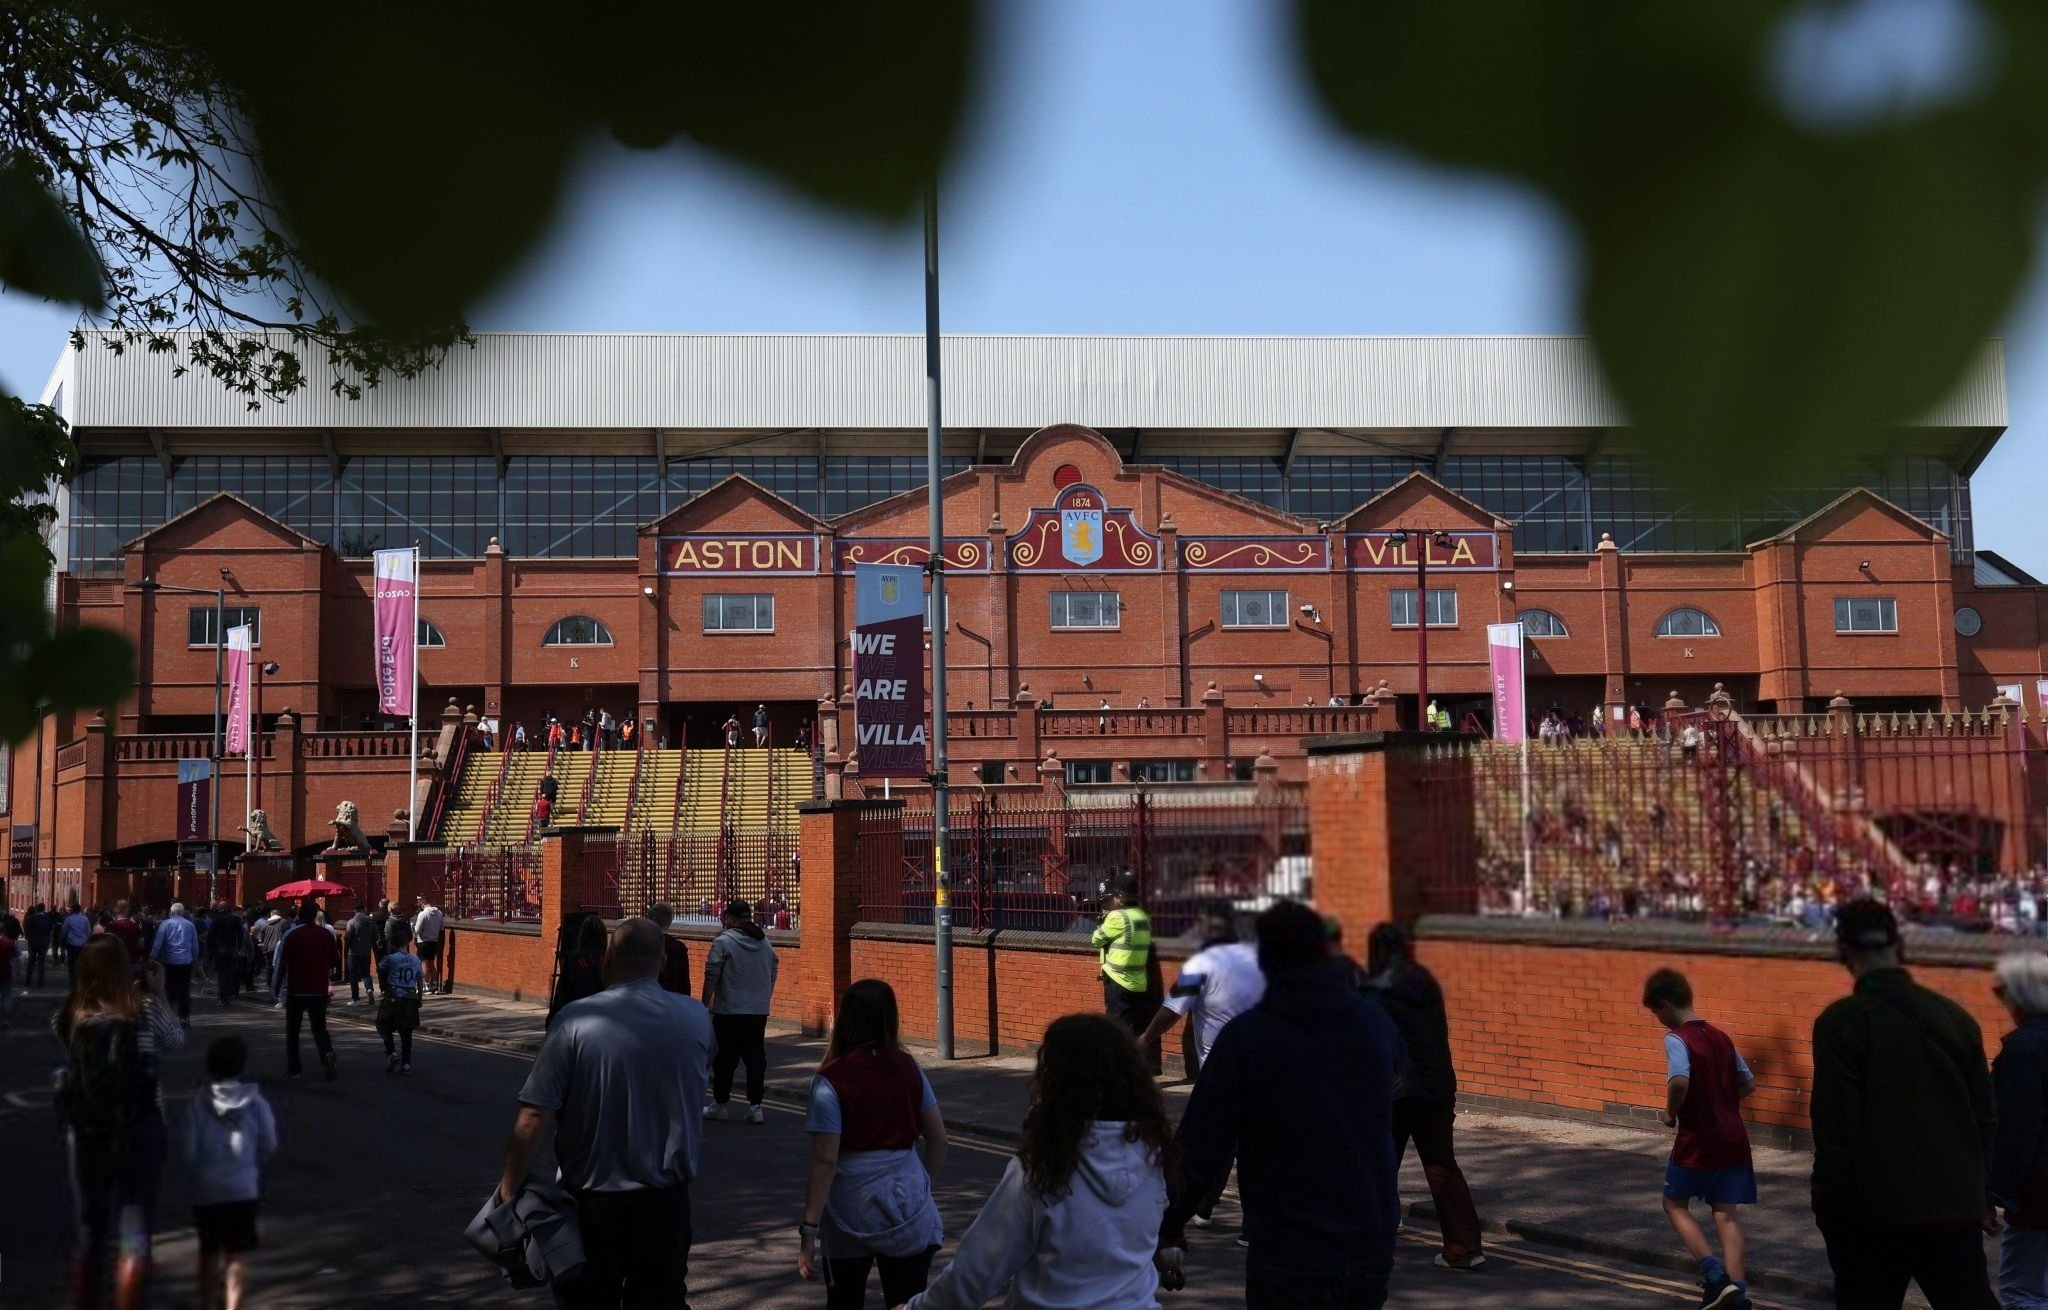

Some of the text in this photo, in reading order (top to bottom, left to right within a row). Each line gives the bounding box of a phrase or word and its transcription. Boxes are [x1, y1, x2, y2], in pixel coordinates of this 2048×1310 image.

[1072, 498, 1091, 508] 1874
[1065, 511, 1099, 521] AVFC
[674, 540, 802, 569] ASTON
[1364, 537, 1476, 565] VILLA
[856, 633, 897, 655] WE
[1685, 648, 1693, 657] K
[570, 657, 579, 667] K
[1532, 650, 1539, 659] K
[857, 678, 908, 700] ARE
[858, 723, 926, 746] VILLA
[859, 746, 926, 769] VILLA
[399, 967, 414, 983] 10
